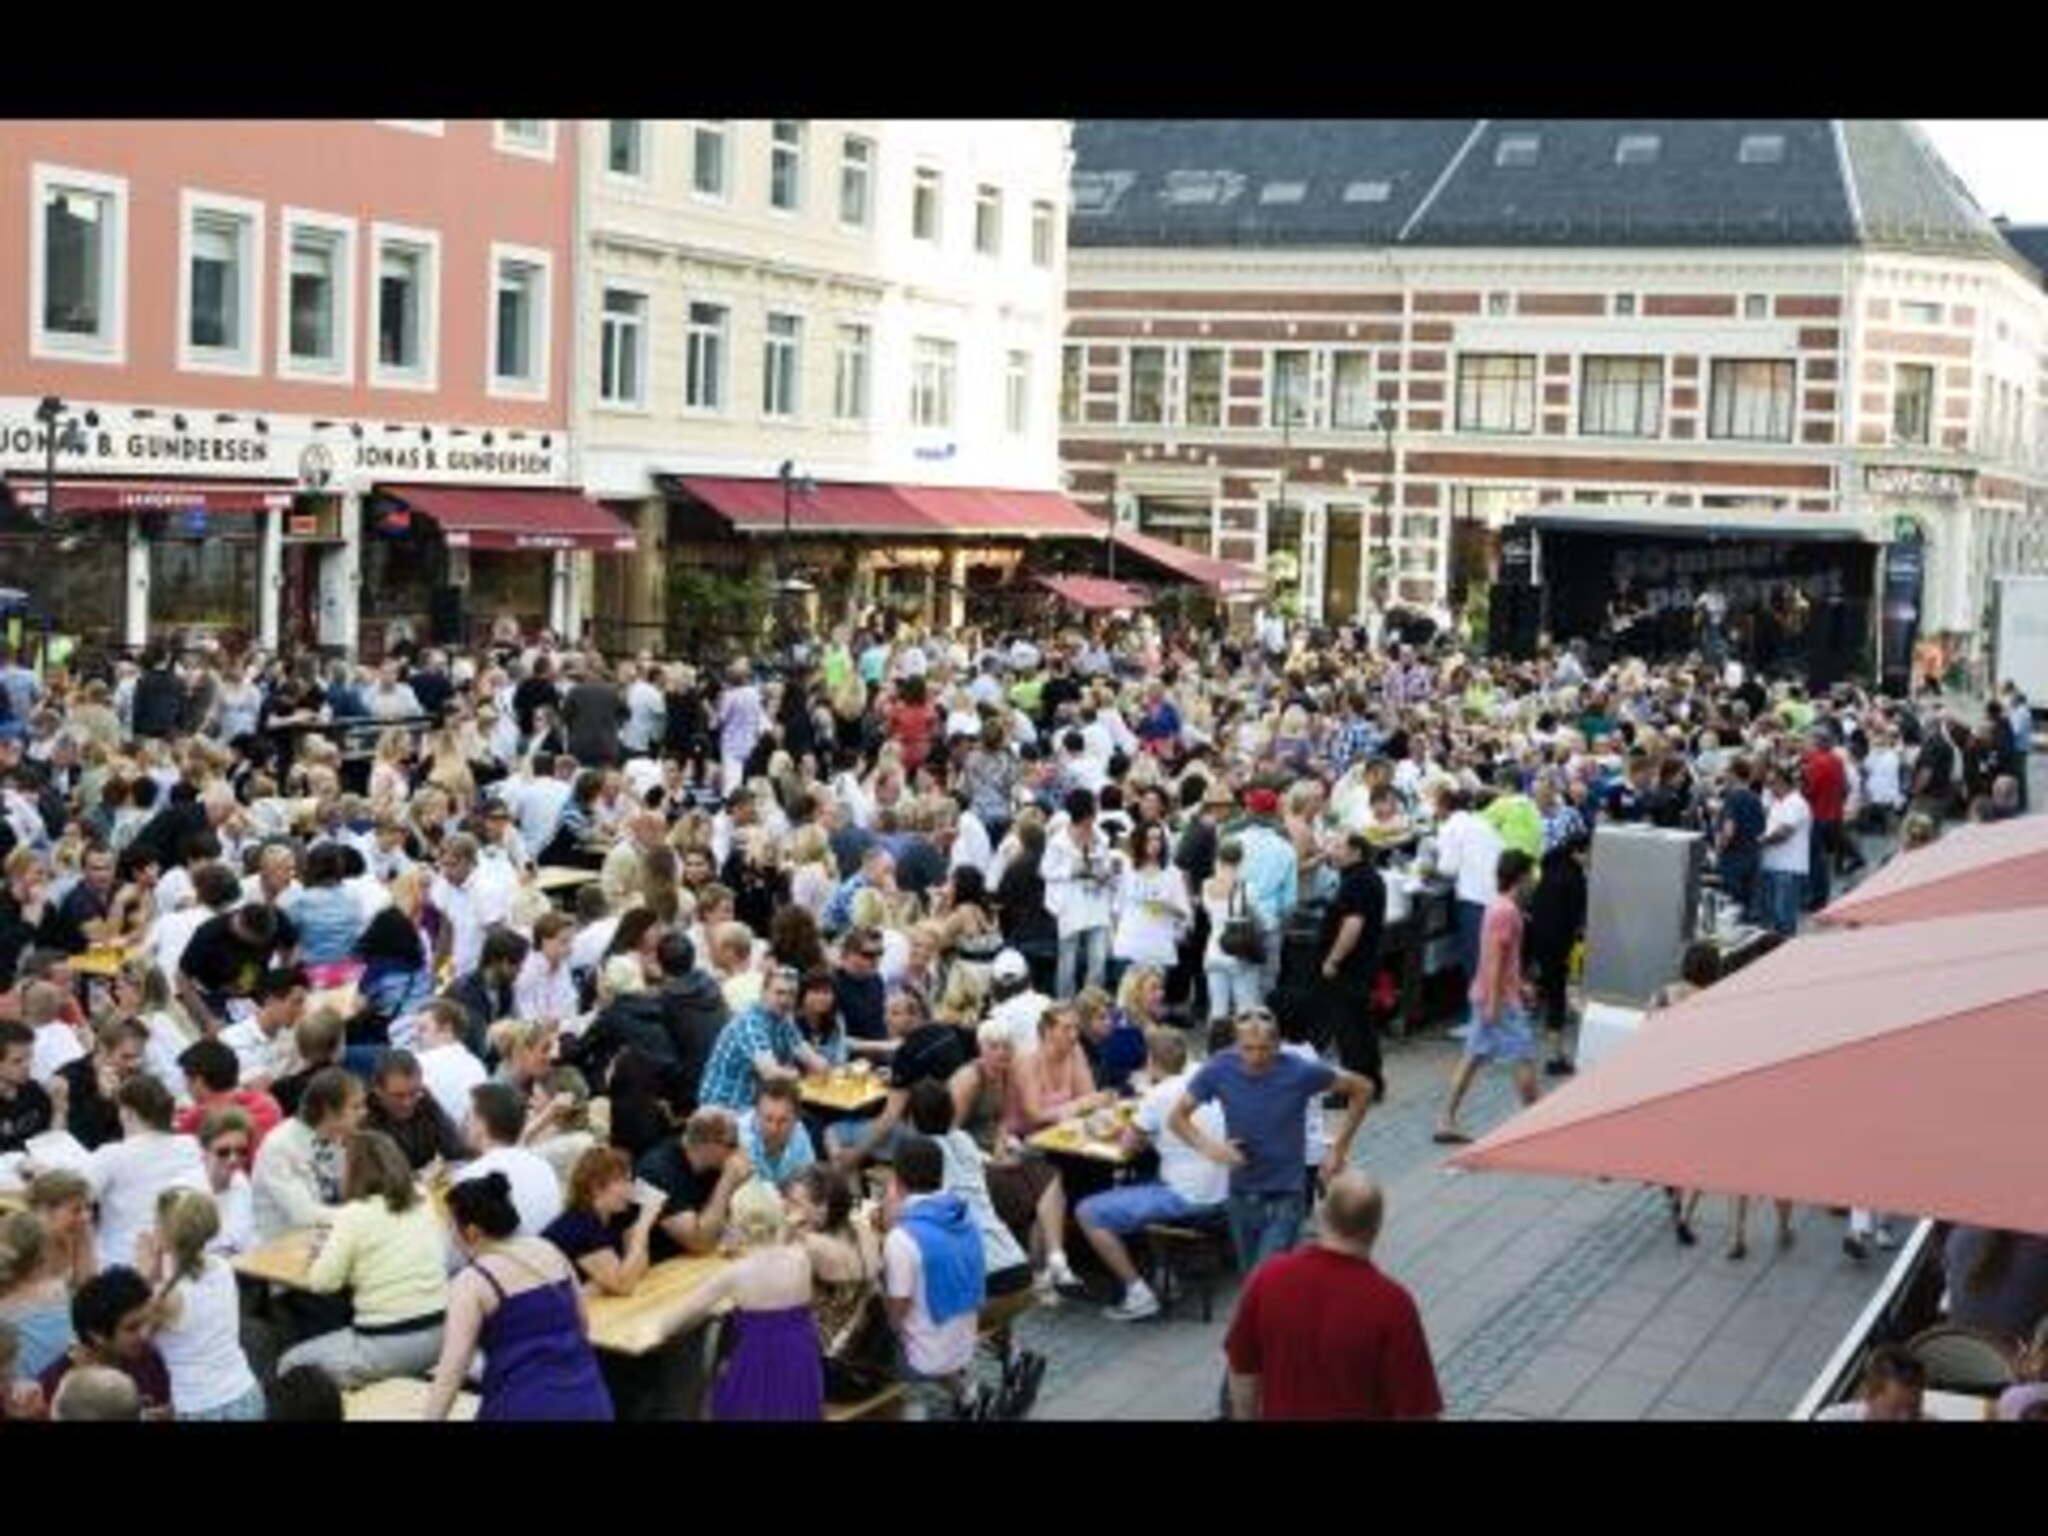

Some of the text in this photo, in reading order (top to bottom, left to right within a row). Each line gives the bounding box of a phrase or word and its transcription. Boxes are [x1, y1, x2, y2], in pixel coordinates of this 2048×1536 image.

[127, 434, 267, 462] GUNDERSEN
[355, 446, 419, 470] JONAS
[447, 451, 551, 474] GUNDERSEN
